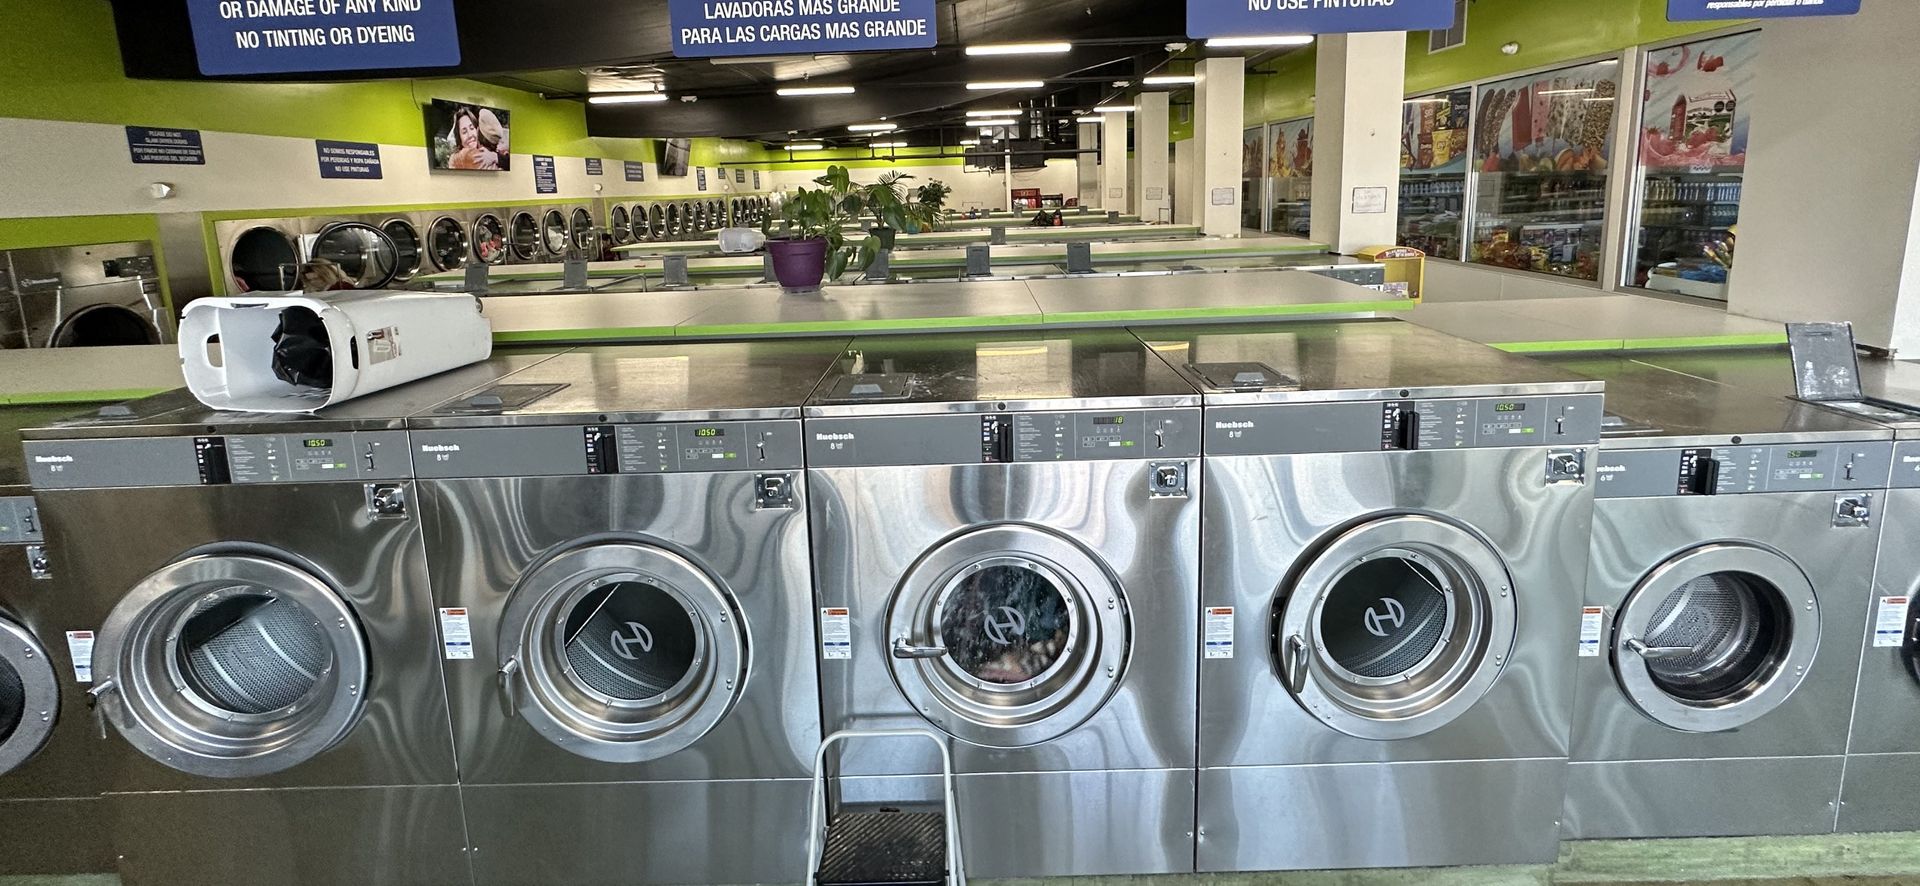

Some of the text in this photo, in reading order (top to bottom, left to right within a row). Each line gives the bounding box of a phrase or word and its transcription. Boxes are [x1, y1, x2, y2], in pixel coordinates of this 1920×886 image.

[219, 0, 421, 18] OR DAMAGE OF ANY KIND
[704, 0, 900, 20] LAVADORAS MAS GRANDE
[1248, 0, 1271, 10] NO
[1277, 0, 1308, 10] USE
[1706, 0, 1753, 10] responsables
[1752, 0, 1766, 8] por
[236, 24, 415, 48] NO TINTING OR DYEING
[681, 19, 926, 45] PARA LAS CARGAS MAS GRANDE
[1215, 420, 1254, 428] Huebsch
[698, 428, 716, 436] 1050
[816, 432, 855, 440] Huebsch
[421, 444, 460, 452] Huebsch
[830, 442, 836, 450] 8
